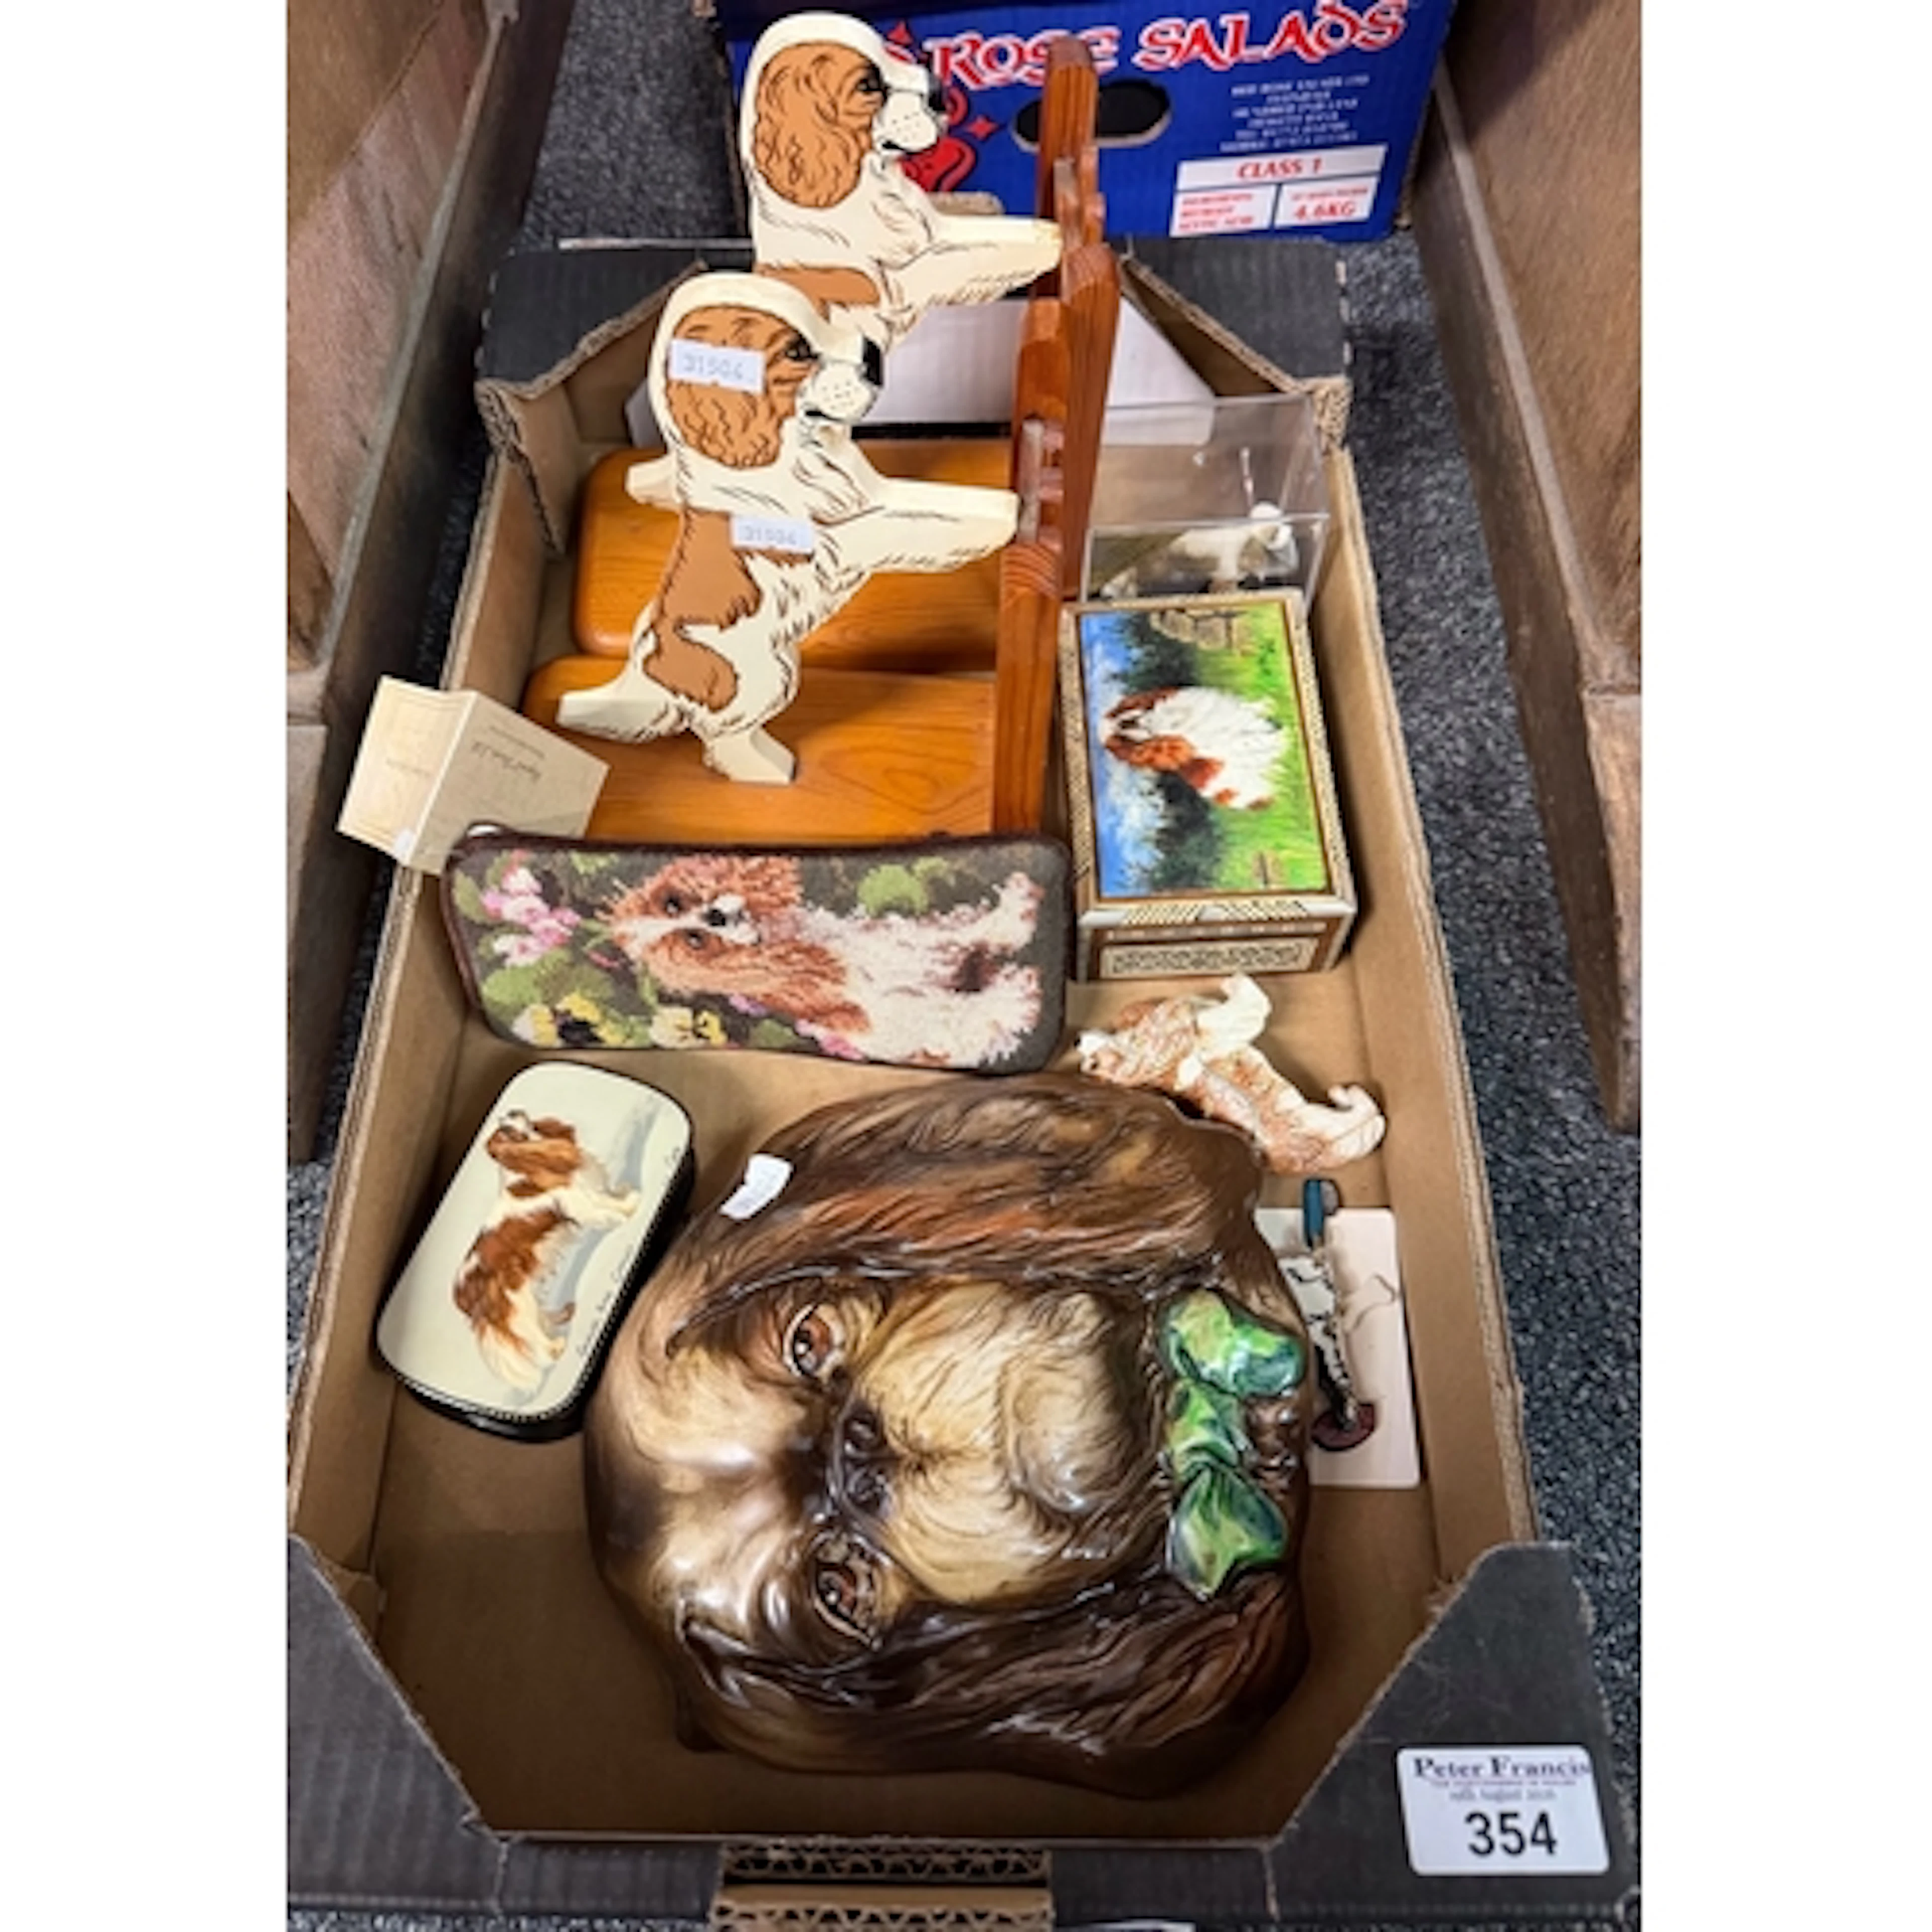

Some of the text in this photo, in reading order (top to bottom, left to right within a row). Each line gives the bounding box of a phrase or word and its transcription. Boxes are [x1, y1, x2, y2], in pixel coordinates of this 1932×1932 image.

[1132, 0, 1408, 70] SALADS
[1236, 157, 1324, 179] CLASS 1
[1413, 1755, 1591, 1778] Peter Francis
[1464, 1810, 1557, 1857] 354
